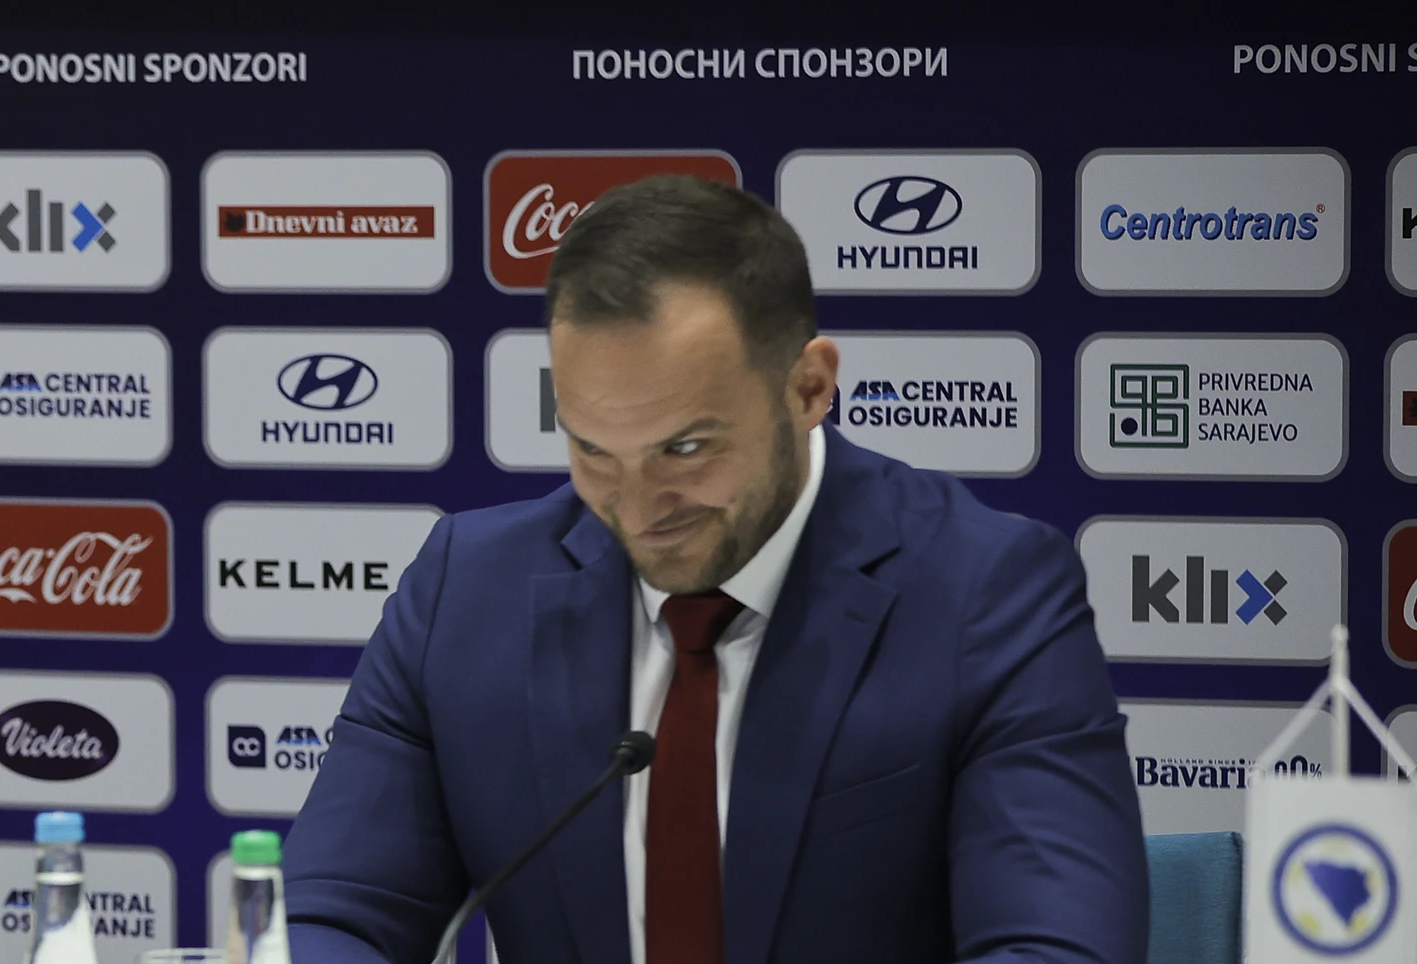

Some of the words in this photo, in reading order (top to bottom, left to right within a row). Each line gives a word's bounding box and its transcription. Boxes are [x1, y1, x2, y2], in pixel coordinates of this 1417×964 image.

[143, 52, 307, 82] SPONZORI
[572, 49, 745, 79] ПОНОСНИ
[755, 47, 948, 78] СПОНЗОРИ
[1233, 43, 1396, 74] PONOSNI
[245, 209, 345, 234] Dnevni
[351, 211, 418, 234] avaz
[1100, 204, 1319, 241] Centrotrans
[838, 245, 978, 270] HYUNDAI
[45, 373, 151, 395] CENTRAL
[849, 380, 901, 402] ASA
[901, 380, 1018, 403] CENTRAL
[1198, 373, 1314, 392] PRIVREDNA
[848, 405, 1018, 428] OSIGURANJE
[1198, 398, 1268, 416] BANKA
[262, 421, 394, 444] HYUNDAI
[1198, 423, 1298, 445] SARAJEVO
[219, 559, 390, 591] KELME
[1132, 555, 1288, 625] klix
[0, 716, 105, 760] Violeta
[1135, 756, 1253, 789] Bavari
